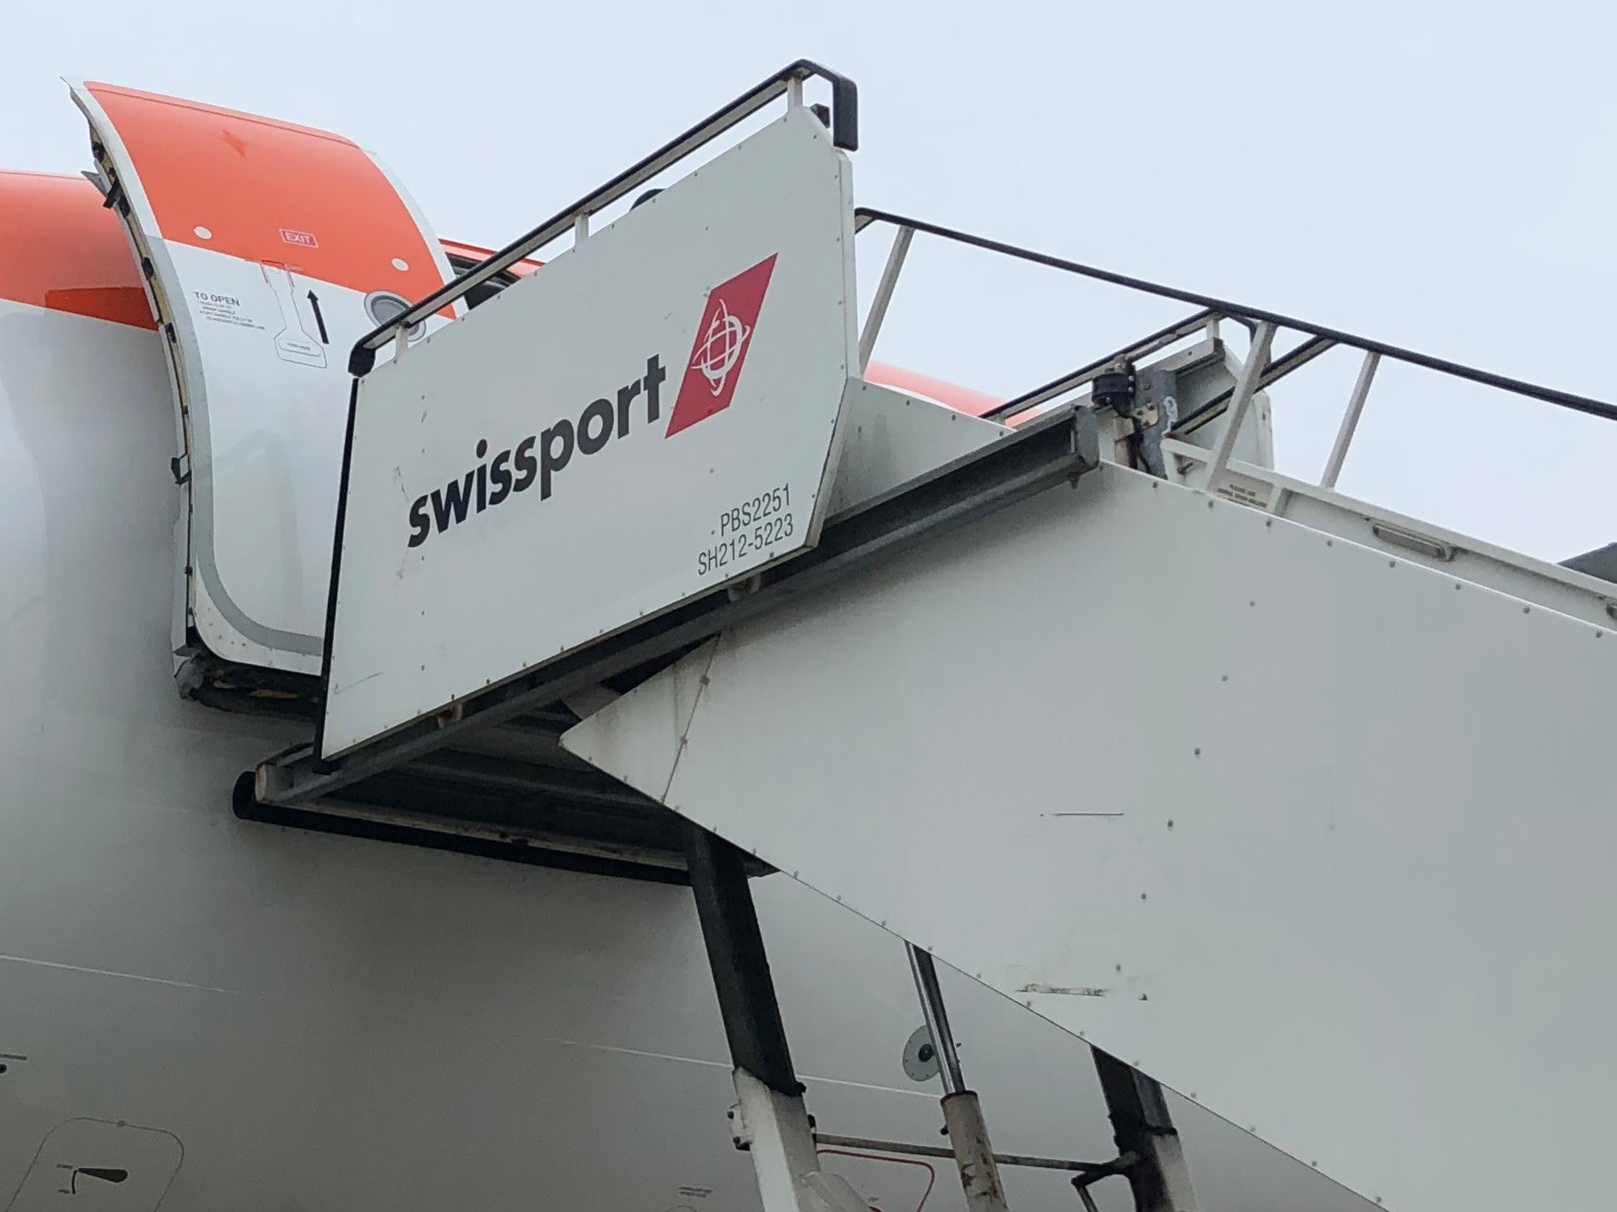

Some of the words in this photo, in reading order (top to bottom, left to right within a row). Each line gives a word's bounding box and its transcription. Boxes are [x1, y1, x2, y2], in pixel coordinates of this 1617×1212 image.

[285, 231, 312, 245] EXIT
[194, 291, 208, 301] TO
[210, 294, 240, 306] OPEN
[407, 353, 666, 548] swissport
[720, 483, 790, 537] PBS2251
[698, 513, 794, 576] SH212-5223
